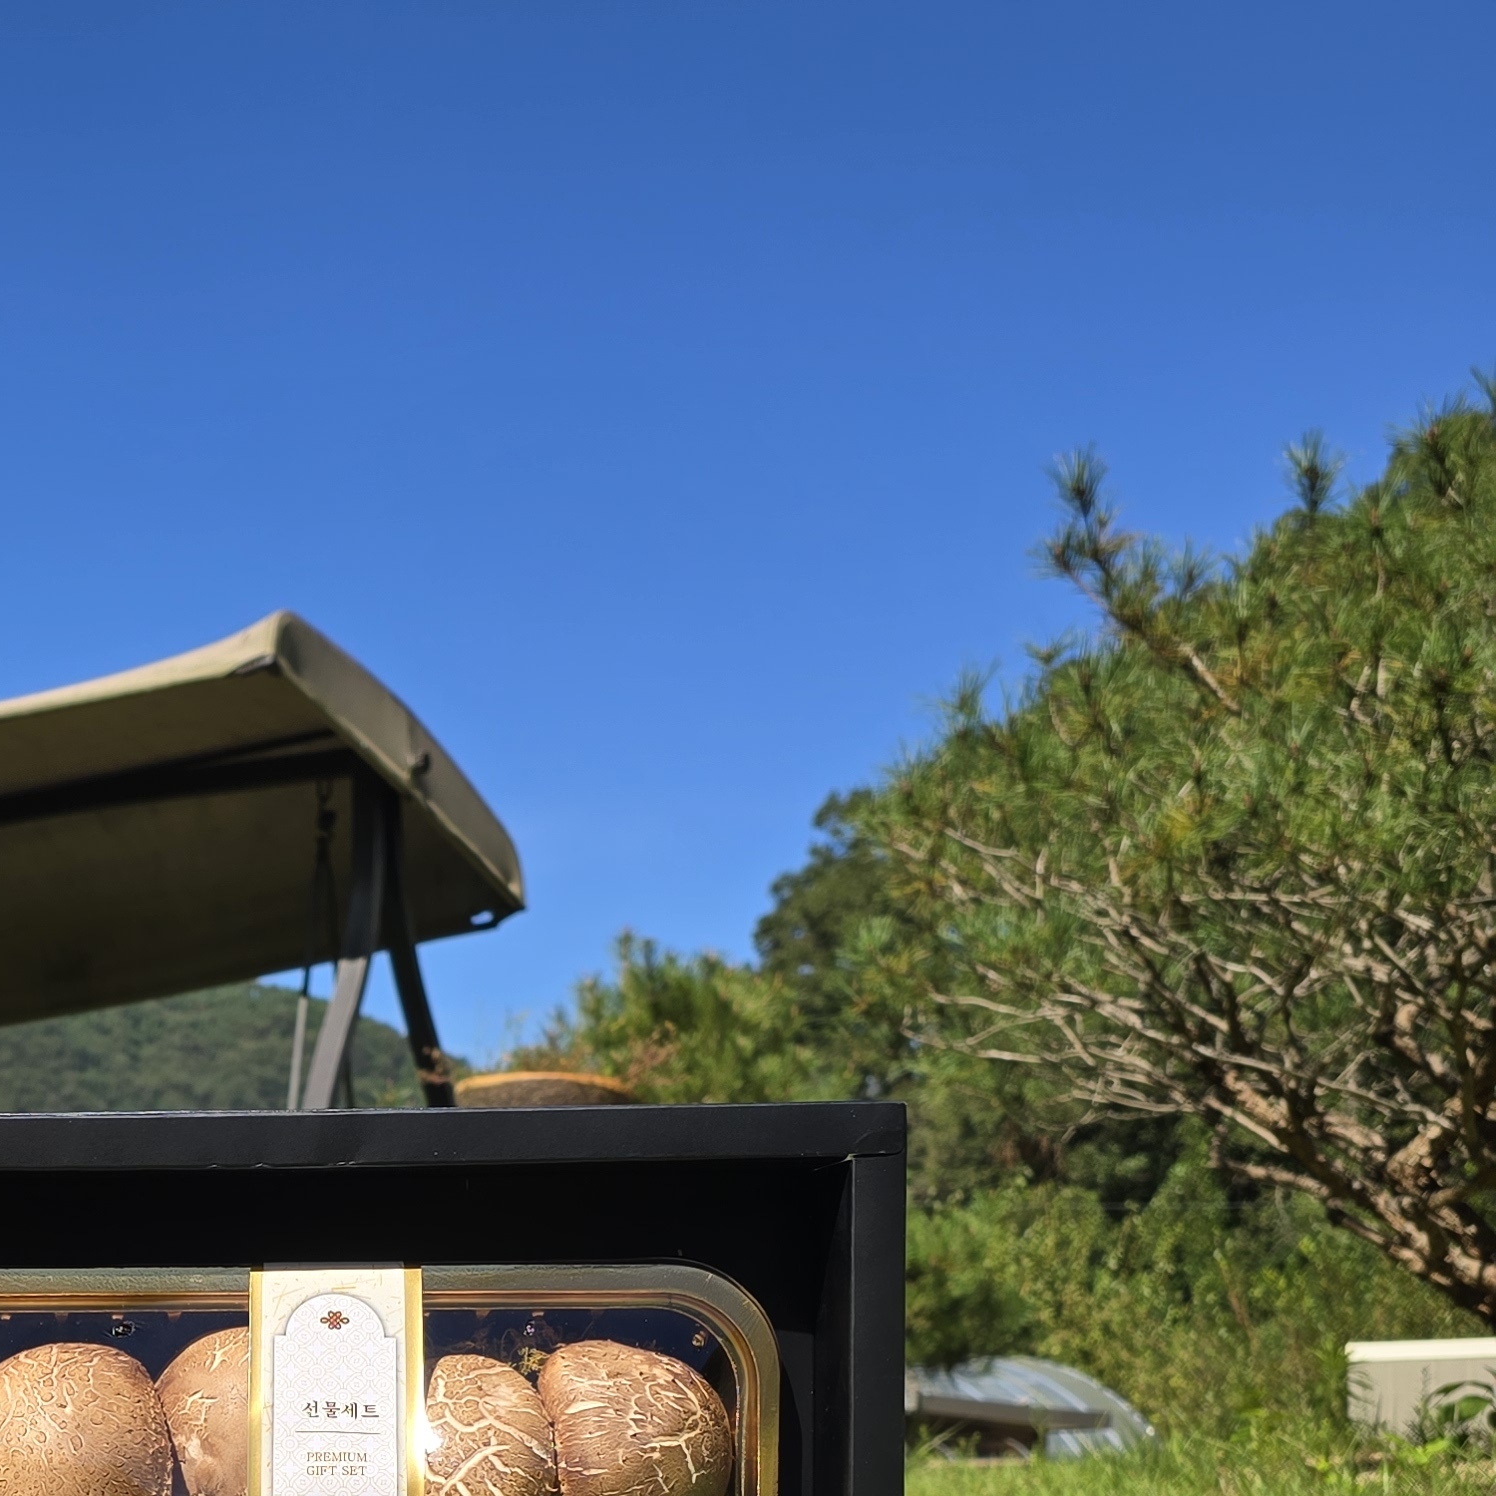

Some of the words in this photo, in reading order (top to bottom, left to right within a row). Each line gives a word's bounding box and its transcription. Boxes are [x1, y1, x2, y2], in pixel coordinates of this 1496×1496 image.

[301, 1399, 380, 1420] 선물세트
[306, 1451, 368, 1463] PREMIUM
[306, 1465, 338, 1476] GIFT
[341, 1465, 368, 1476] SET
